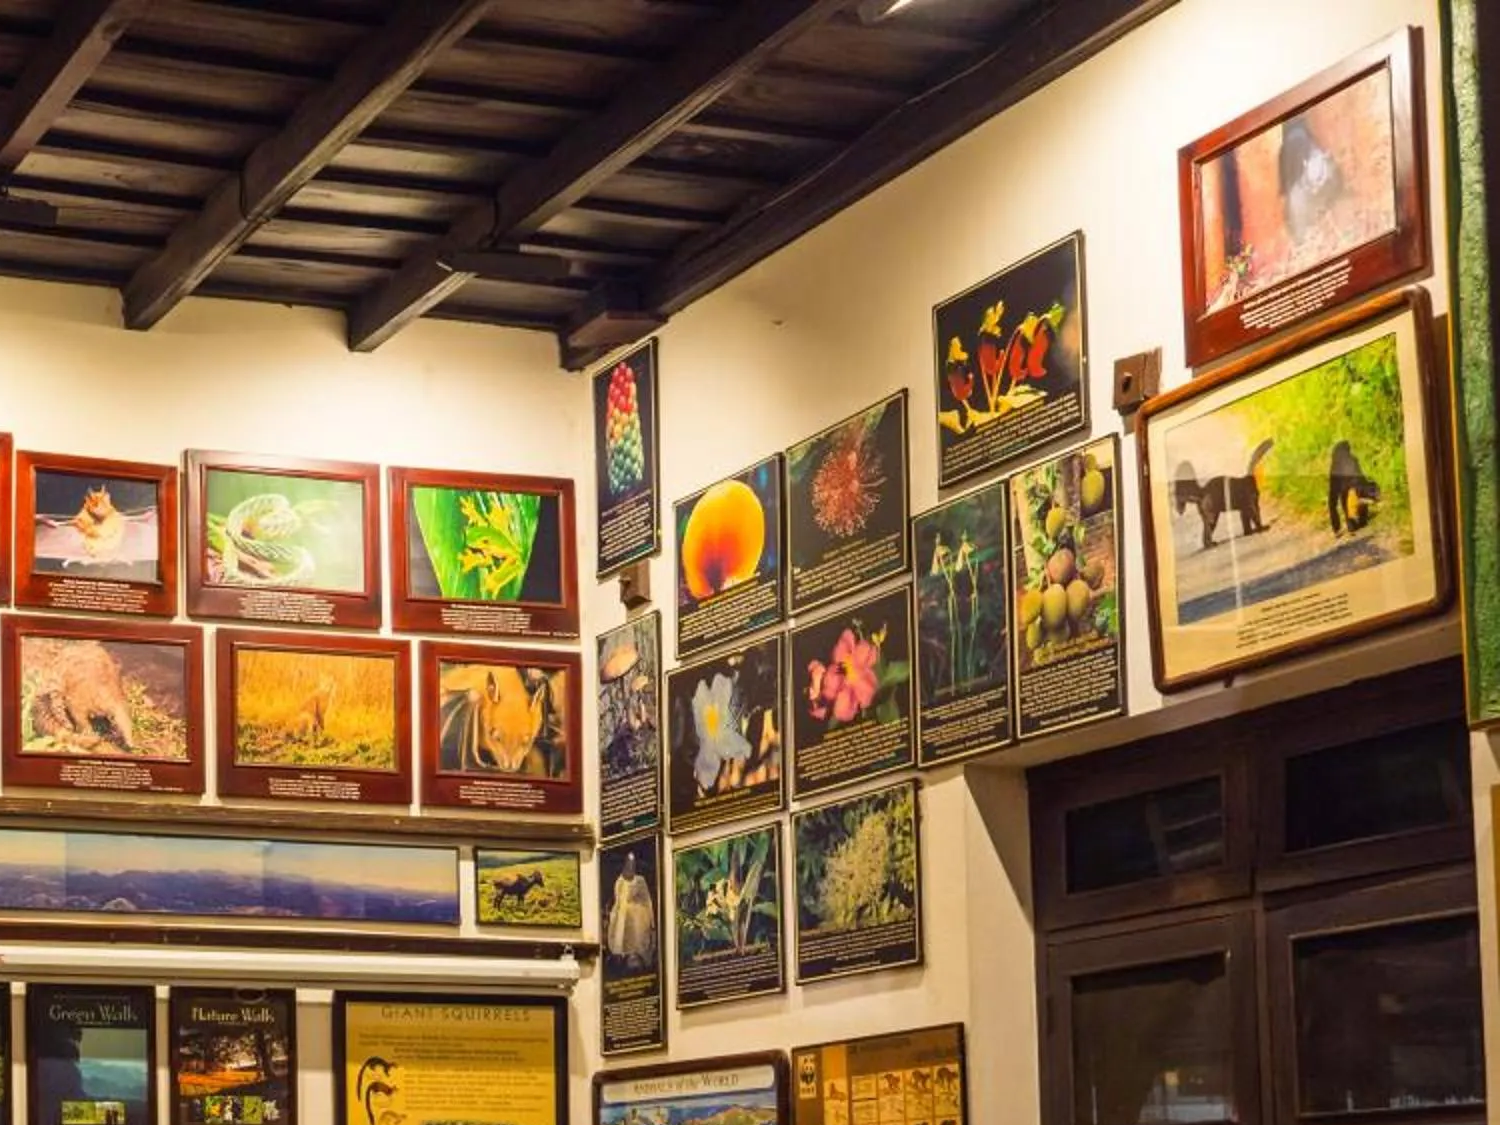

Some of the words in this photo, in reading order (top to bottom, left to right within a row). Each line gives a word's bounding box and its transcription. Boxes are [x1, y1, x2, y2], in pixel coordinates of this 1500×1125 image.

[49, 1004, 95, 1022] Green
[192, 1007, 238, 1023] Nature
[381, 1005, 433, 1020] GIANT
[441, 1006, 531, 1022] SQUIRRELS
